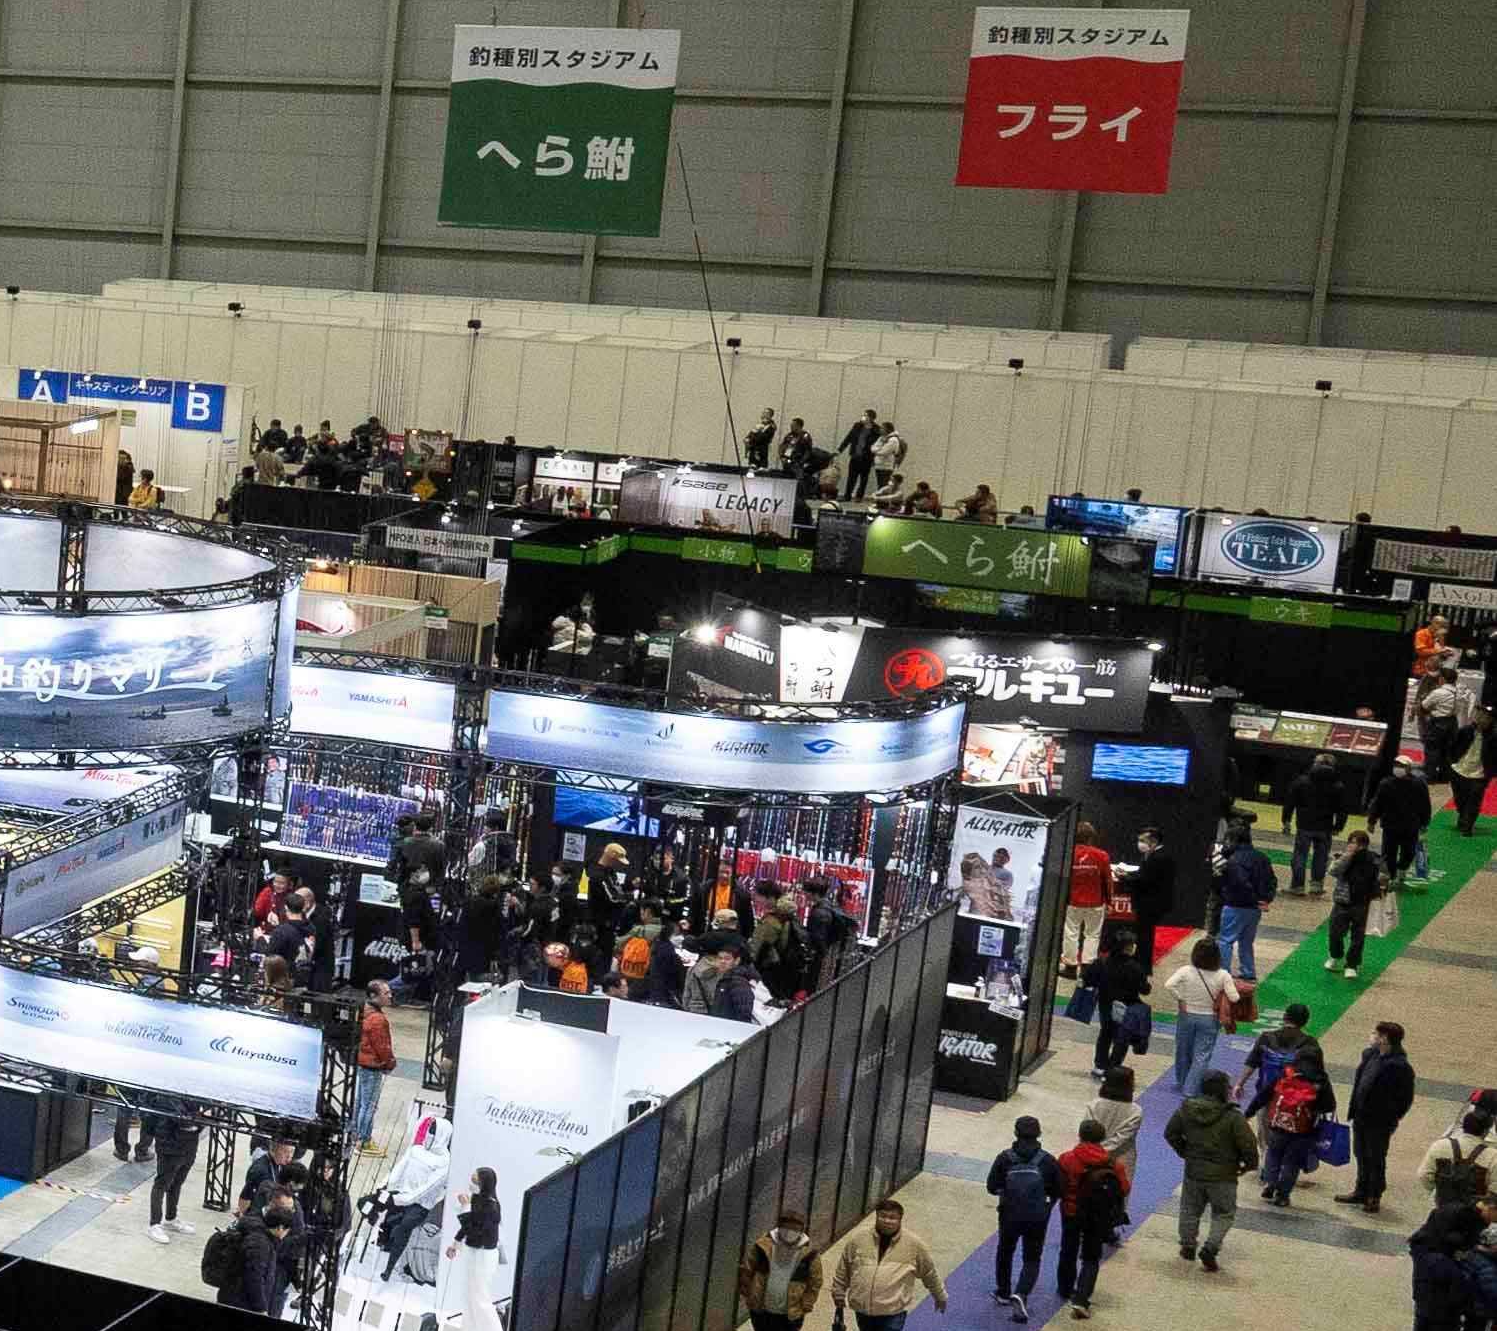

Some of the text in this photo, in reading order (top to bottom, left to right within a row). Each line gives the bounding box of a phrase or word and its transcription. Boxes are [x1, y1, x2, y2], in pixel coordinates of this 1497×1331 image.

[986, 22, 1172, 48] 釣種別スタジアム
[469, 47, 660, 72] 釣種別スタジアム
[995, 103, 1142, 145] フライ
[477, 135, 635, 181] へら鮒
[32, 379, 53, 401] A
[186, 391, 210, 421] B
[716, 494, 783, 514] LEGACY
[901, 535, 1060, 585] へら鮒
[1231, 542, 1308, 565] TEAL
[963, 815, 1037, 840] ALLIGATOR
[231, 1047, 298, 1066] Hayabusa
